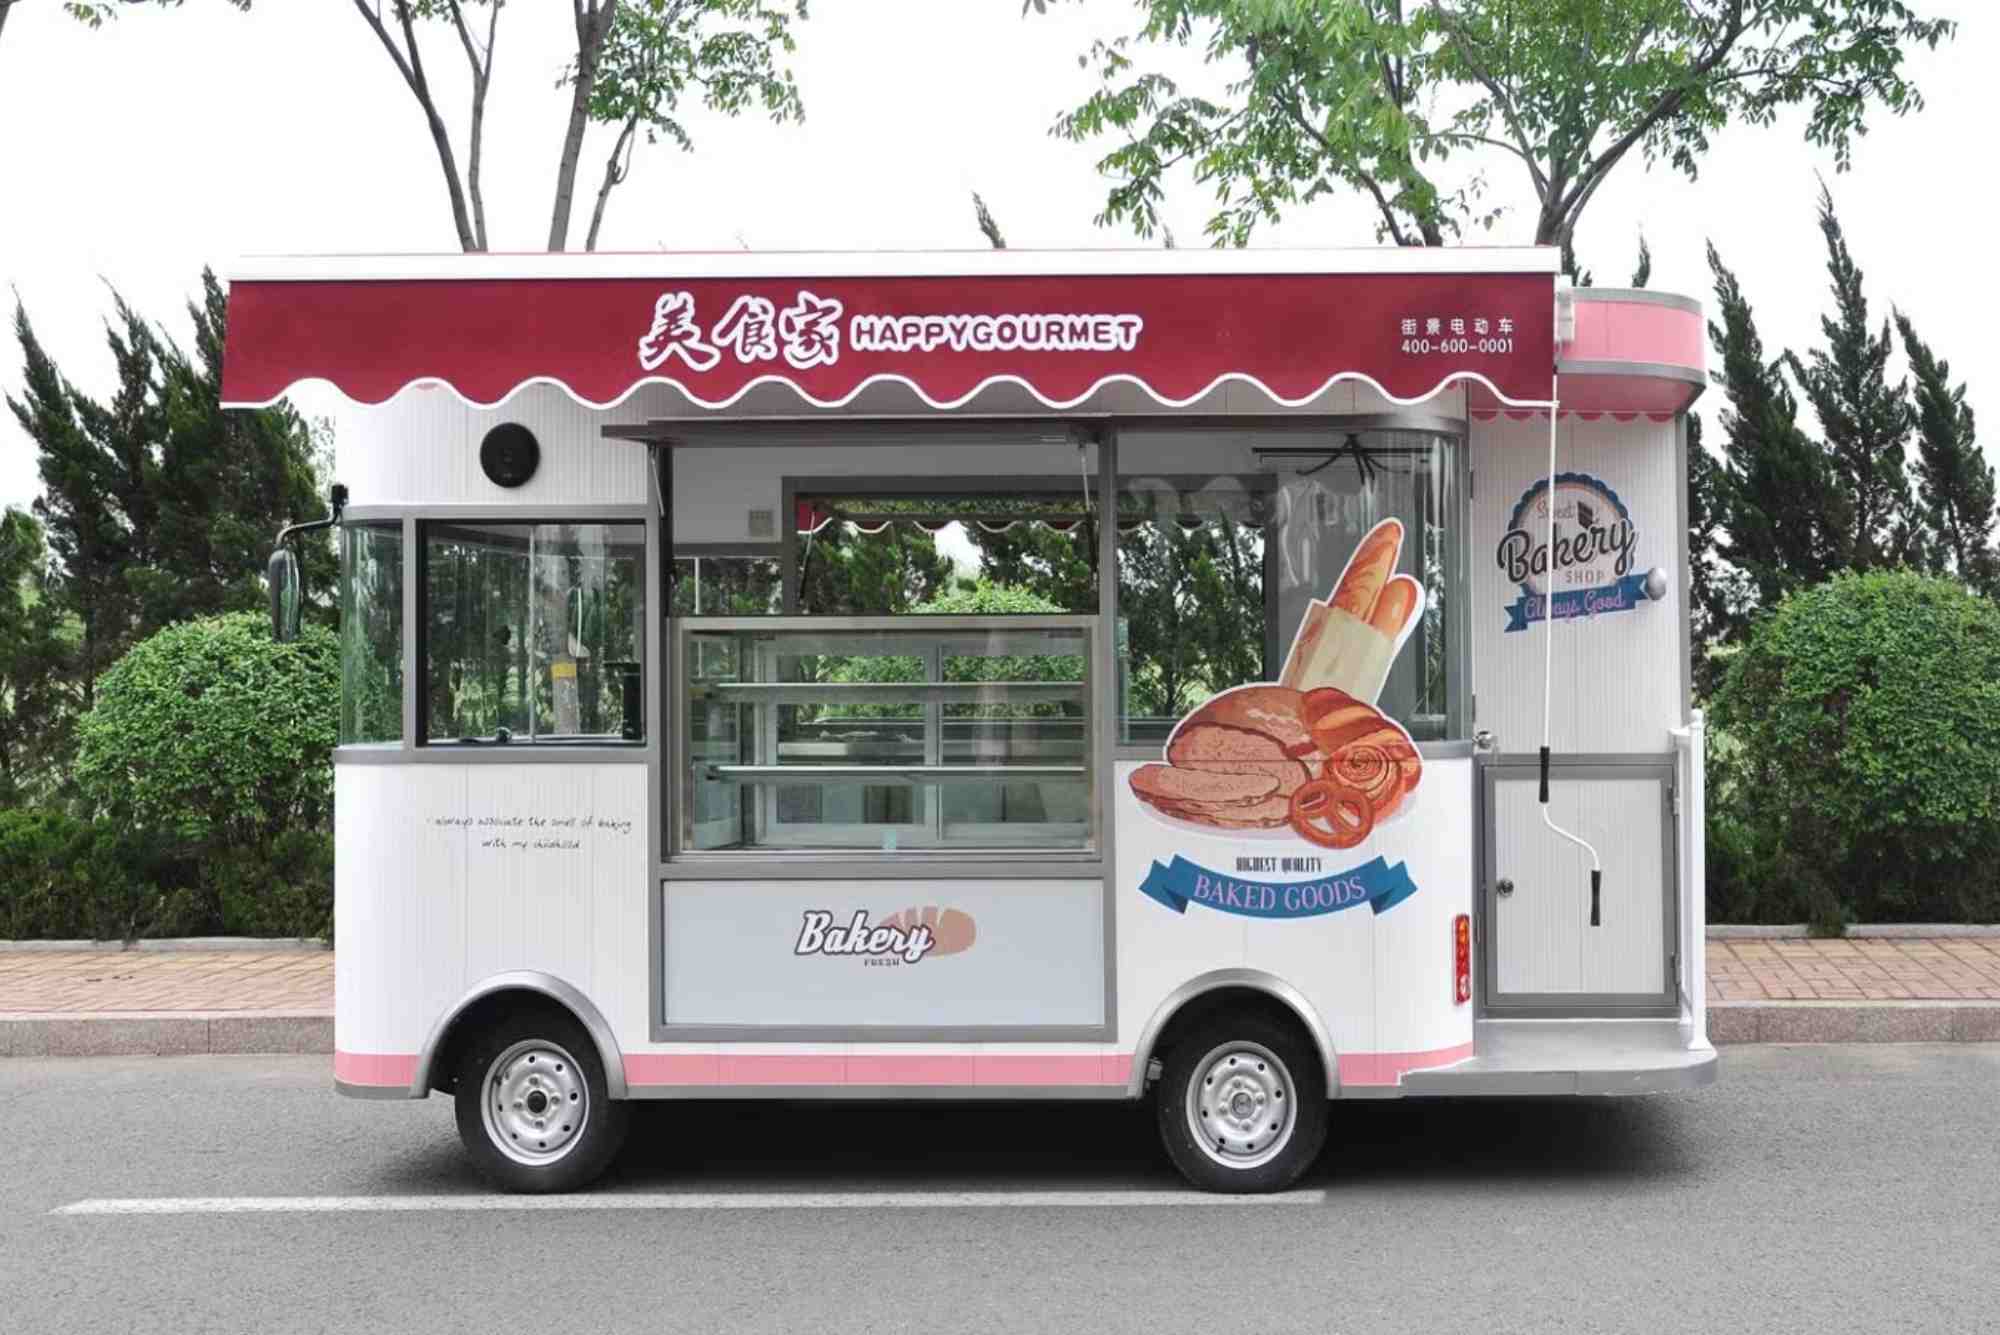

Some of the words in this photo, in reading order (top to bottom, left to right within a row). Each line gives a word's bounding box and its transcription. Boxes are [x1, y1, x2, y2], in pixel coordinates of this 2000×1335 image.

[638, 291, 843, 371] 美食家
[850, 313, 1144, 352] HAPPYGOURMET
[1401, 339, 1513, 353] 400-600-0001
[1497, 519, 1636, 583] Bakery
[1565, 570, 1604, 583] SHOP
[528, 815, 547, 827] the
[481, 837, 507, 848] with
[511, 840, 528, 852] my
[1236, 856, 1277, 872] HIGHEST
[1281, 856, 1322, 874] QUALITY
[1193, 875, 1276, 910] BAKED
[1284, 875, 1367, 910] GOODS
[794, 910, 937, 964] Bakery
